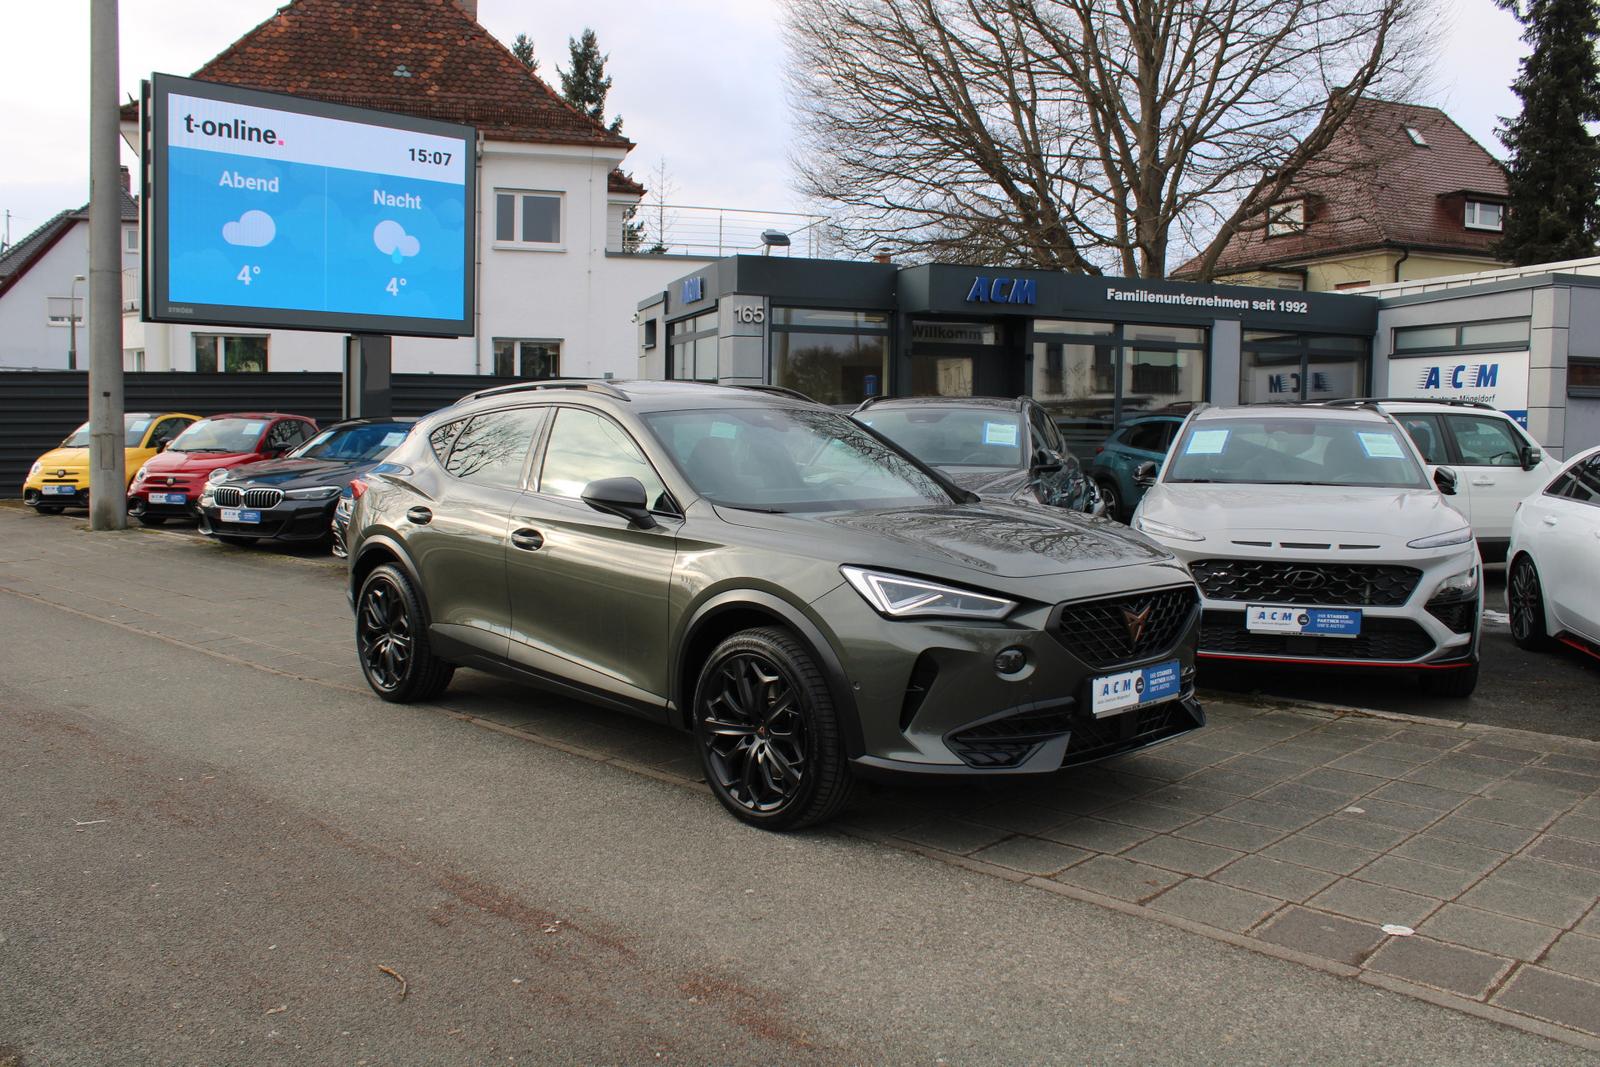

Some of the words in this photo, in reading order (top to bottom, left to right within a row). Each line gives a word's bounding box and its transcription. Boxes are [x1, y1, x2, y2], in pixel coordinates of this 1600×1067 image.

[184, 113, 284, 146] t-online.
[408, 147, 452, 166] 15:07
[219, 171, 280, 193] Abend
[373, 189, 422, 210] Nacht
[236, 265, 261, 286] 4°
[386, 277, 407, 297] 4°
[966, 276, 1037, 304] ACM
[1107, 288, 1249, 309] Familienunternehmen
[1252, 298, 1275, 311] seit
[1279, 300, 1307, 313] 1992
[734, 305, 764, 323] 165
[911, 323, 1000, 342] Willkomm
[1417, 364, 1499, 389] ACM
[1258, 612, 1292, 621] ACM
[1102, 679, 1131, 696] ACM
